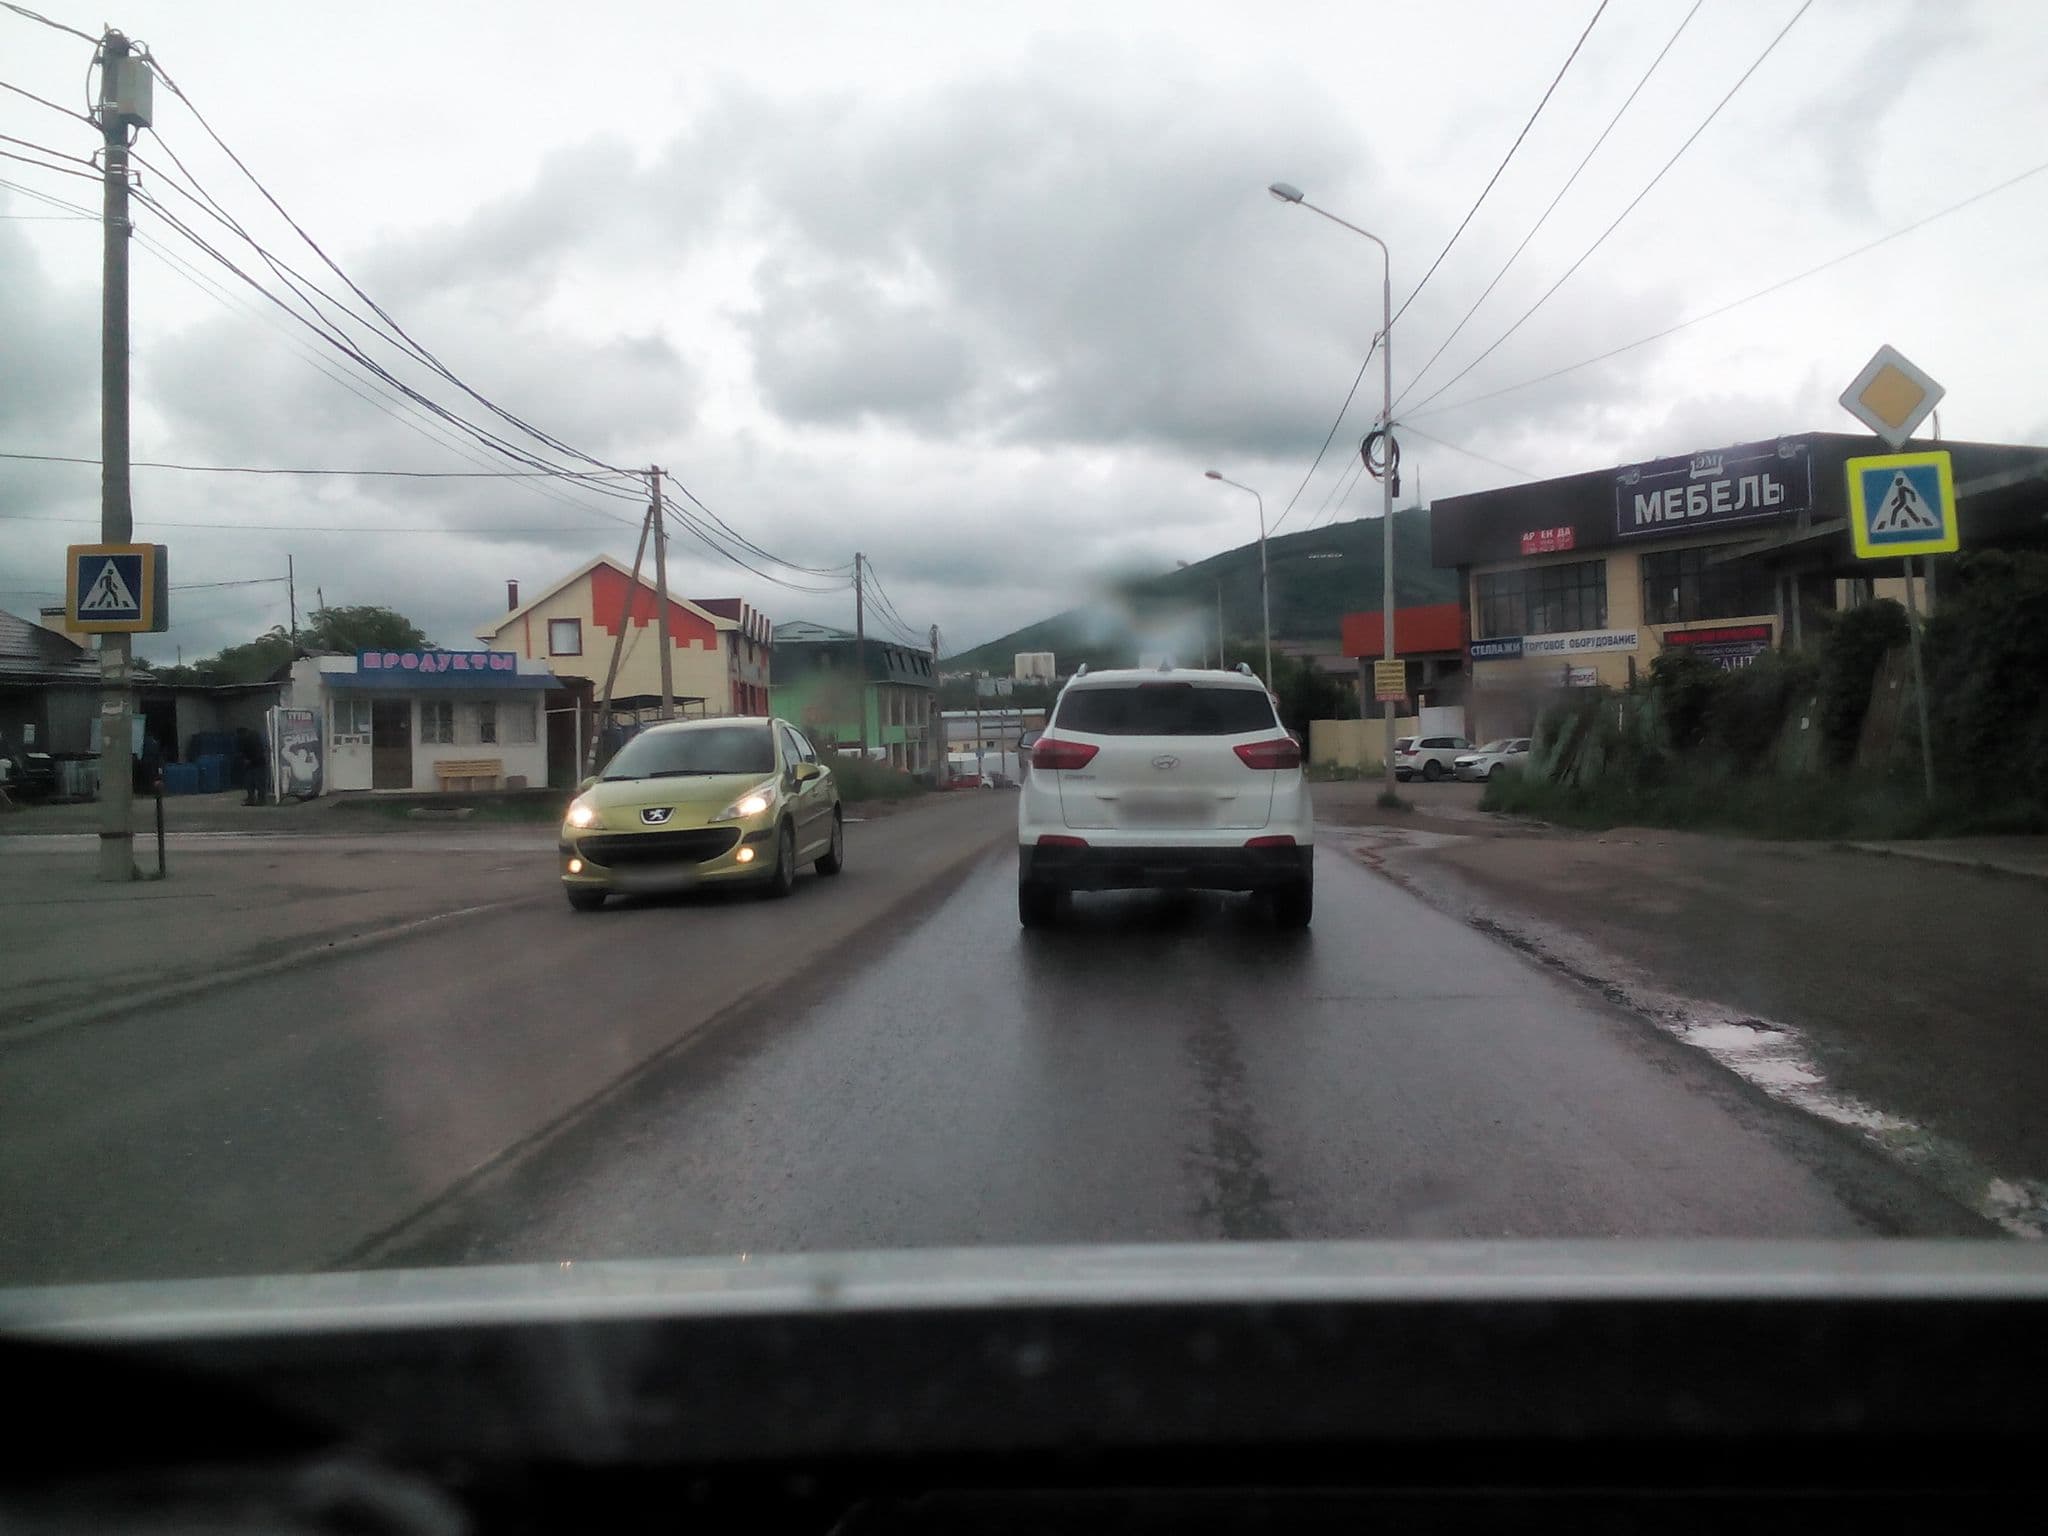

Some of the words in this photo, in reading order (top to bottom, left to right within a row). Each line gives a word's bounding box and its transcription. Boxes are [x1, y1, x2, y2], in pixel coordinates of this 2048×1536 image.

[1634, 473, 1785, 525] МЕБЕЛЬ
[1471, 643, 1521, 657] СТЕЛЛАЖИ
[1525, 639, 1566, 651] ТОРГОВОЕ
[1569, 633, 1637, 649] ОБОРУДОВАНИЕ
[363, 652, 513, 673] ПРОДУКТЫ
